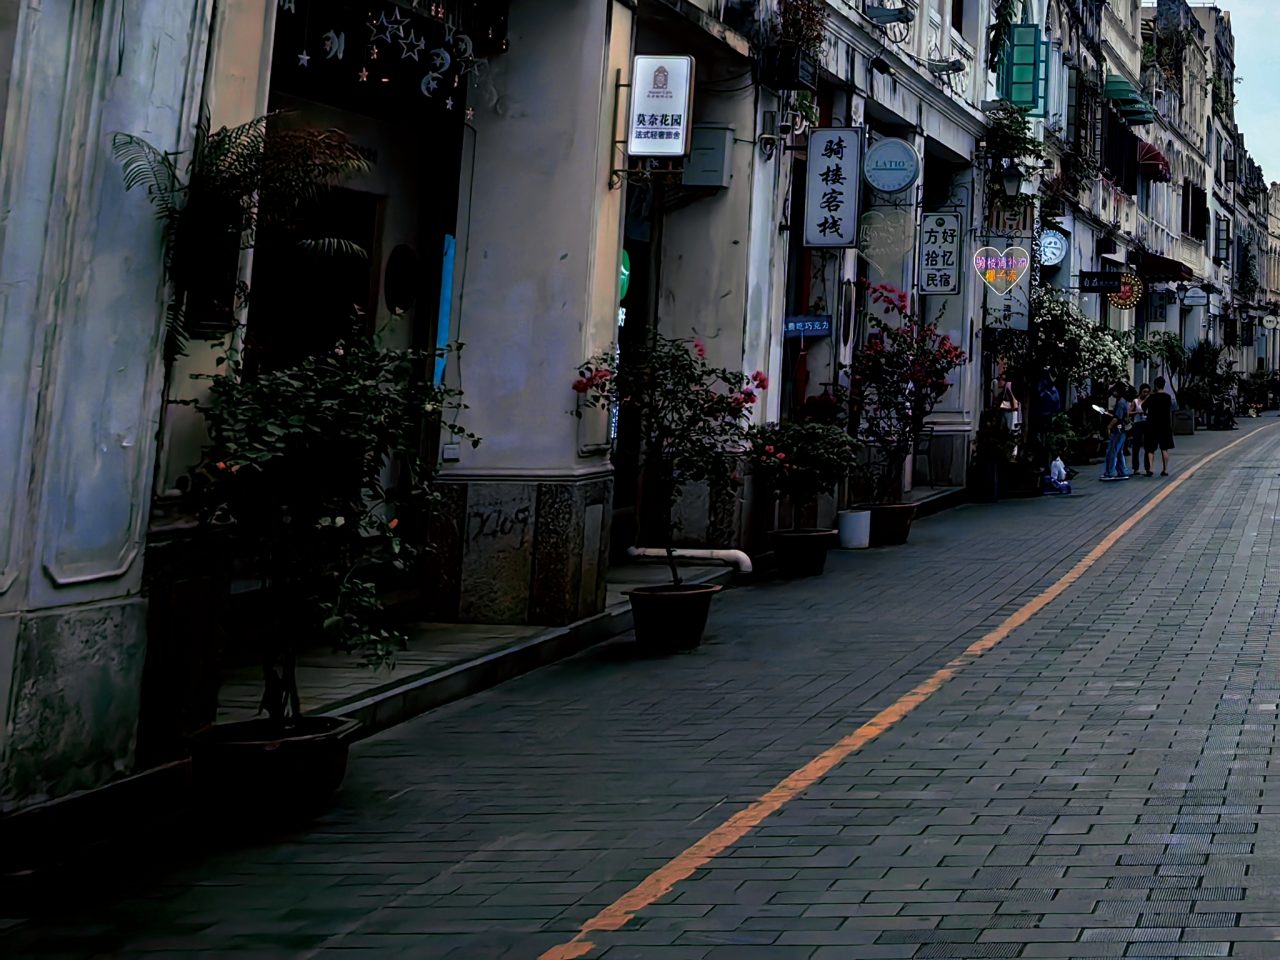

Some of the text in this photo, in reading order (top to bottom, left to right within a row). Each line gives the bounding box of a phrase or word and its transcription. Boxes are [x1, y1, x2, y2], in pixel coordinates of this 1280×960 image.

[637, 114, 682, 126] 莫奈花园
[817, 136, 847, 238] 骑楼客栈
[926, 273, 951, 287] 民宿
[785, 321, 829, 331] 费吃巧克力
